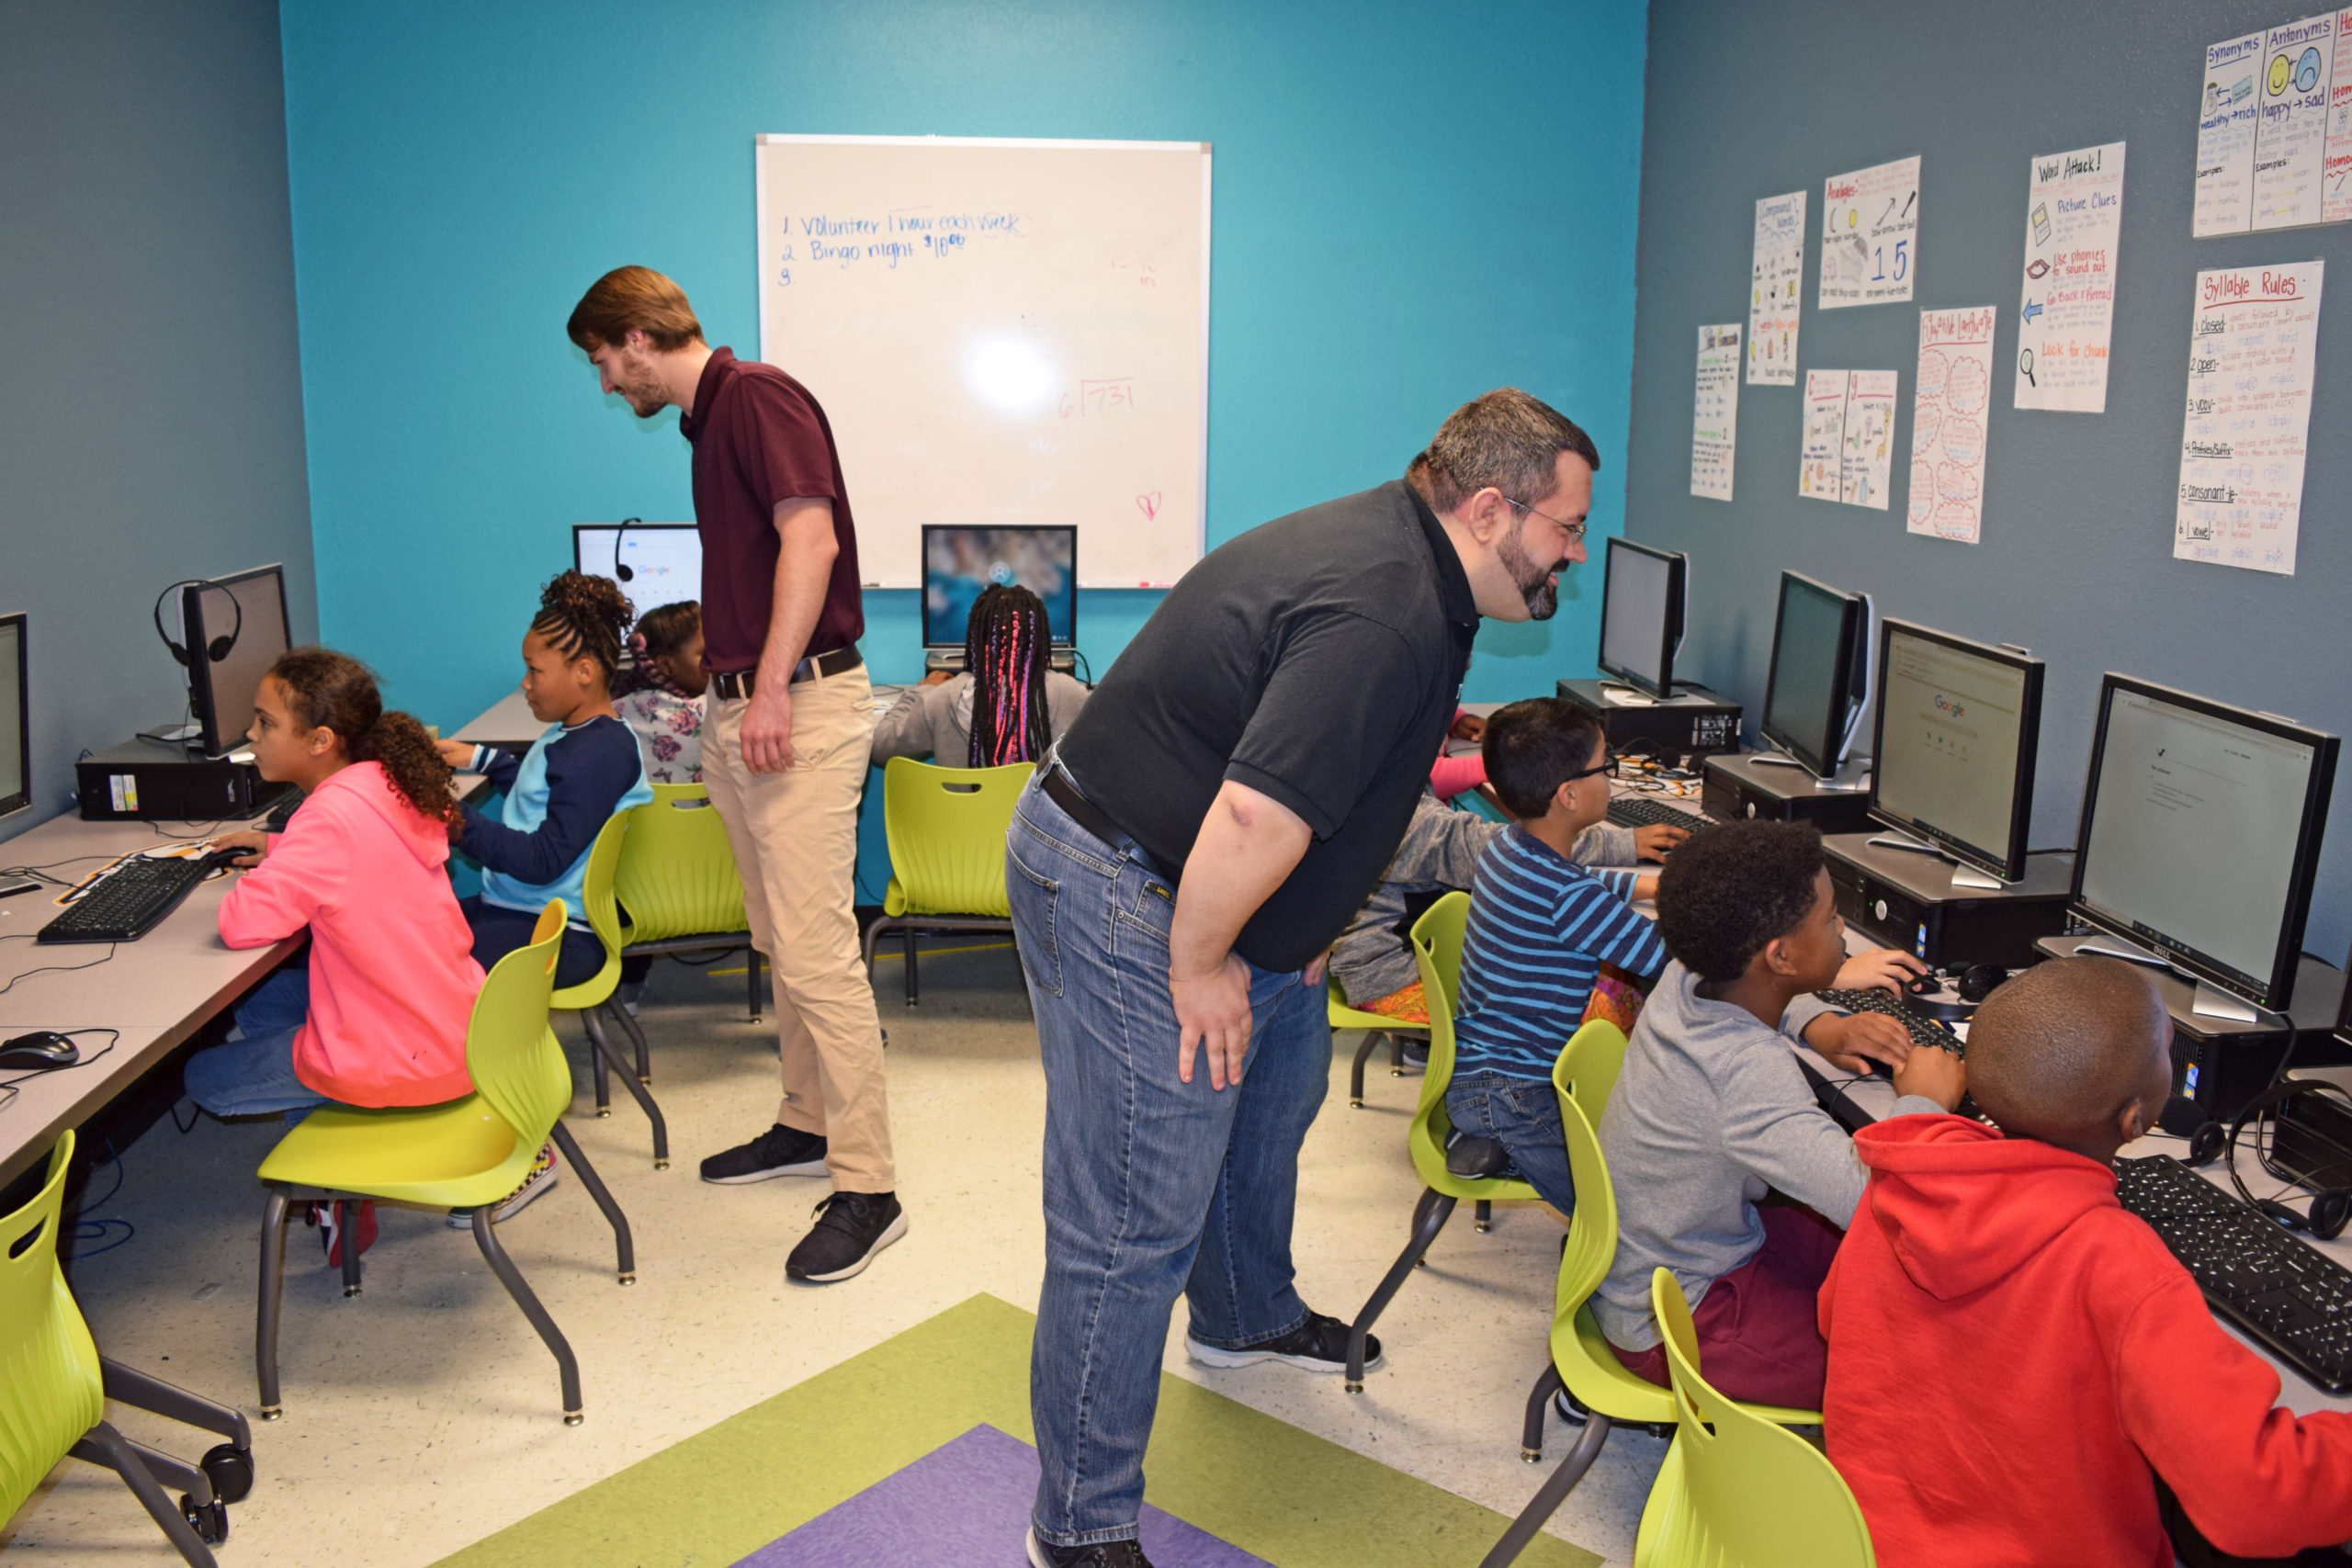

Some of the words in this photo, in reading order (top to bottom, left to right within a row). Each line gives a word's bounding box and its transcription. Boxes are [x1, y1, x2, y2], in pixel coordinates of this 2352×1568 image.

[2269, 20, 2331, 47] Antonyms
[2208, 38, 2259, 63] Synonyms
[2262, 99, 2291, 122] happy
[2305, 85, 2325, 108] sad
[2199, 114, 2230, 130] wealthy
[2239, 104, 2256, 120] rich
[2039, 159, 2059, 183] Word
[2256, 158, 2290, 173] Examples:
[2325, 154, 2352, 171] Homo
[2058, 197, 2086, 213] Picture
[2091, 191, 2117, 209] Clues
[800, 214, 880, 236] Volunteer
[899, 215, 934, 232] hour
[939, 212, 976, 231] each
[978, 212, 1021, 234] week
[810, 240, 860, 270] Bingo
[868, 242, 916, 269] night
[2053, 253, 2067, 266] Use
[2065, 261, 2089, 275] sound
[2093, 263, 2107, 273] out
[2058, 289, 2079, 303] Back
[2205, 273, 2250, 301] Syllable
[2262, 271, 2296, 296] Rules
[1958, 309, 1992, 340] Language
[2041, 342, 2064, 357] Look
[2069, 339, 2080, 357] for
[1088, 384, 1134, 412] 731
[2188, 484, 2225, 500] consonant
[638, 565, 670, 576] Google
[1935, 694, 1964, 718] Google
[2154, 944, 2171, 960] DELL
